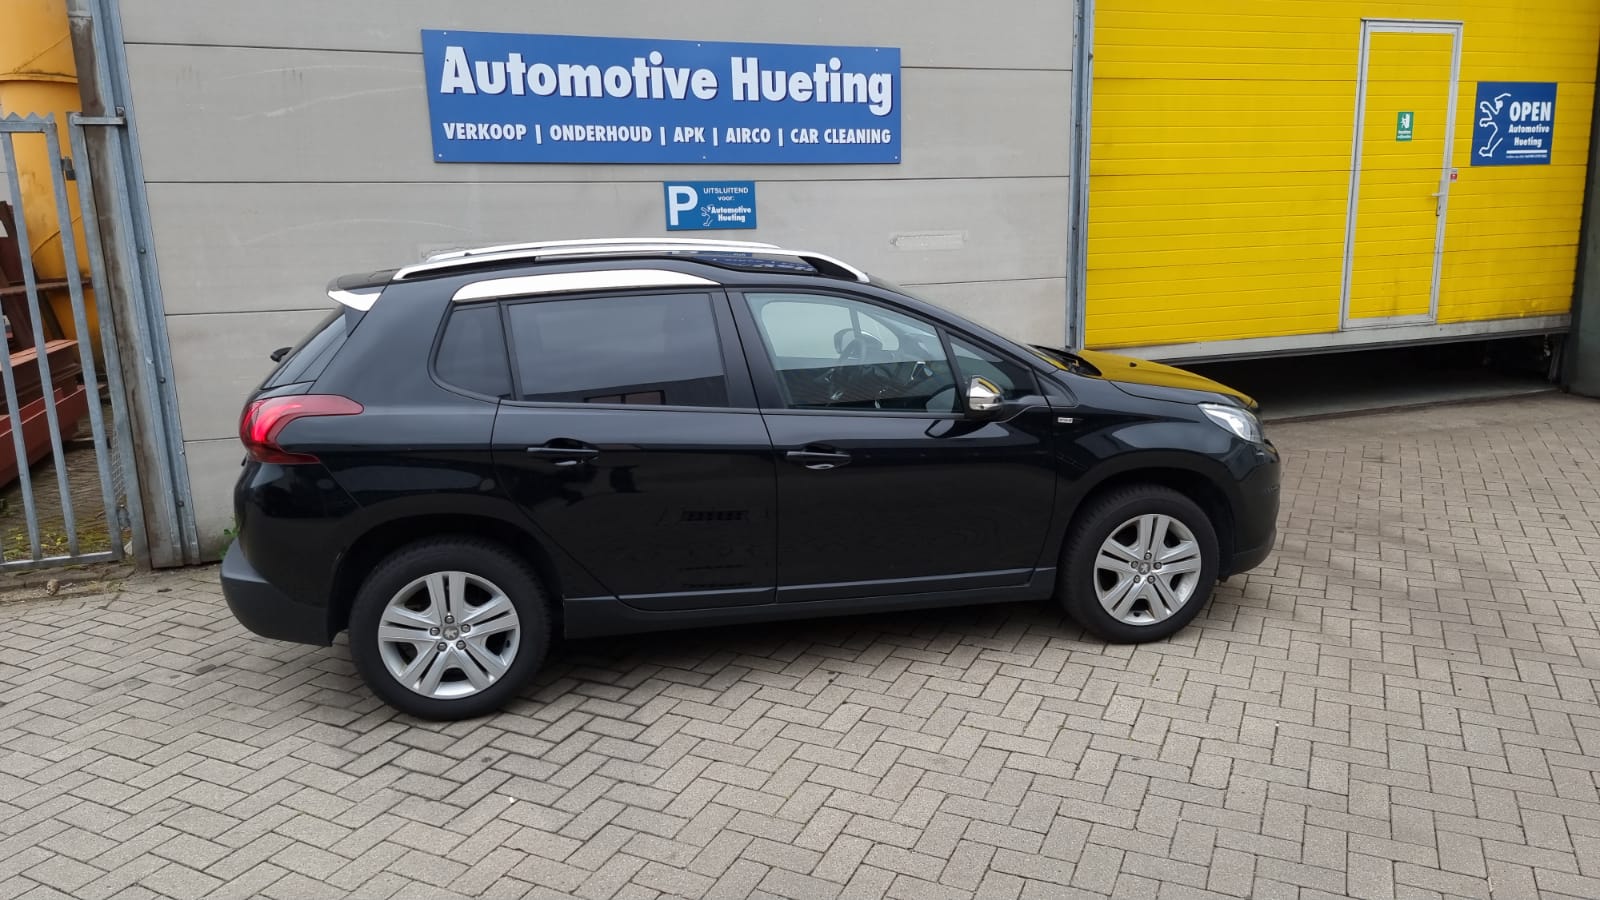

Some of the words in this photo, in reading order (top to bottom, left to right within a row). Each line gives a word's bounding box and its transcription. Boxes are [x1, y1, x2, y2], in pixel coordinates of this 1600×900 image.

[440, 45, 719, 101] Automotive
[731, 56, 894, 116] Hueting
[1509, 101, 1552, 122] OPEN
[443, 122, 527, 141] VERKOOP
[550, 125, 652, 143] ONDERHOUD
[673, 127, 705, 144] APK
[725, 127, 771, 144] AIRCO
[790, 127, 819, 144] CAR
[824, 128, 891, 145] CLEANING
[1508, 124, 1550, 133] Automotive
[1514, 136, 1543, 148] Hueting
[668, 185, 699, 226] P
[711, 205, 752, 214] Automotive
[718, 213, 746, 223] Hueting
